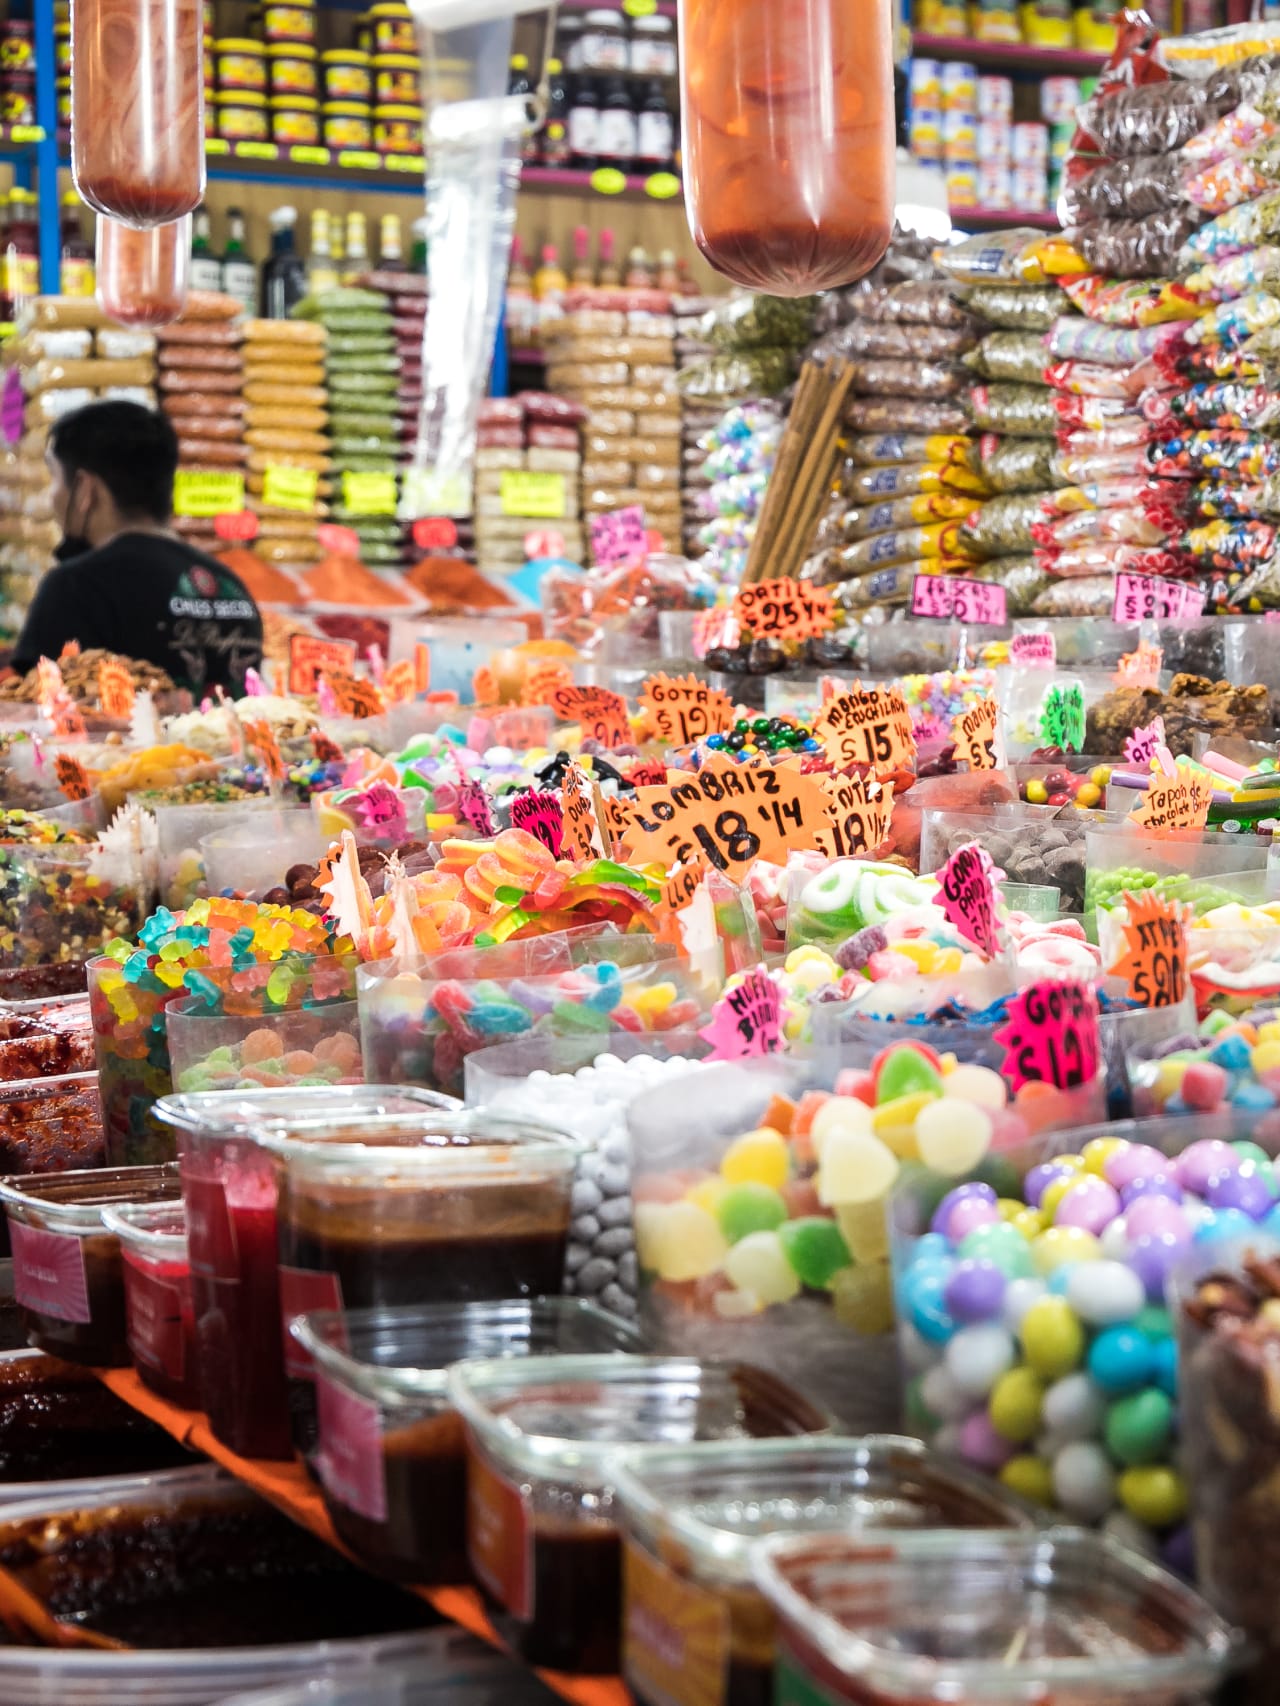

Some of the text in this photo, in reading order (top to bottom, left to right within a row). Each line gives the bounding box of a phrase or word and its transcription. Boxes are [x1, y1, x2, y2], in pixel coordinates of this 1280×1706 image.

[739, 583, 805, 607] DATIL
[652, 684, 708, 705] GOTA
[633, 769, 780, 834] LOMBRIZ
